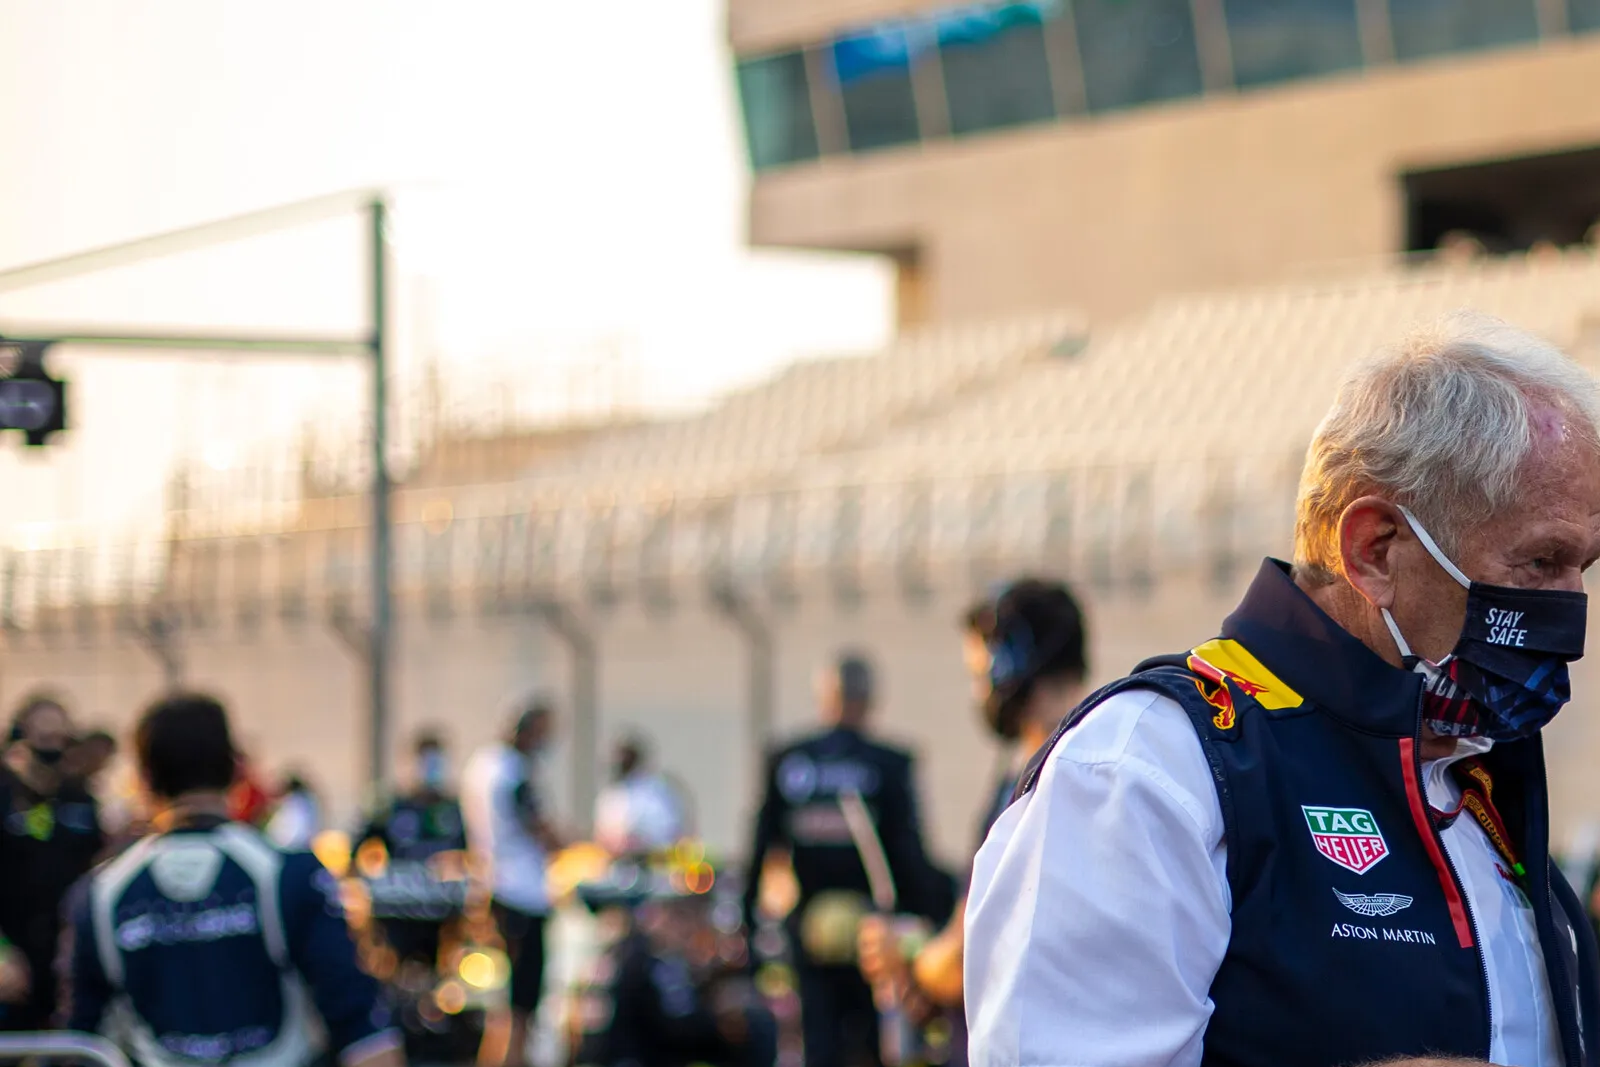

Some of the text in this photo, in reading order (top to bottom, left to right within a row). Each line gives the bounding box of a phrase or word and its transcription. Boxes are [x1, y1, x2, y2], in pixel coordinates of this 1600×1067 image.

[1485, 607, 1525, 629] STAY
[1486, 626, 1528, 647] SAFE
[1308, 811, 1374, 833] TAG
[1317, 836, 1384, 869] HEUER
[1331, 923, 1436, 945] ASTON MARTIN
